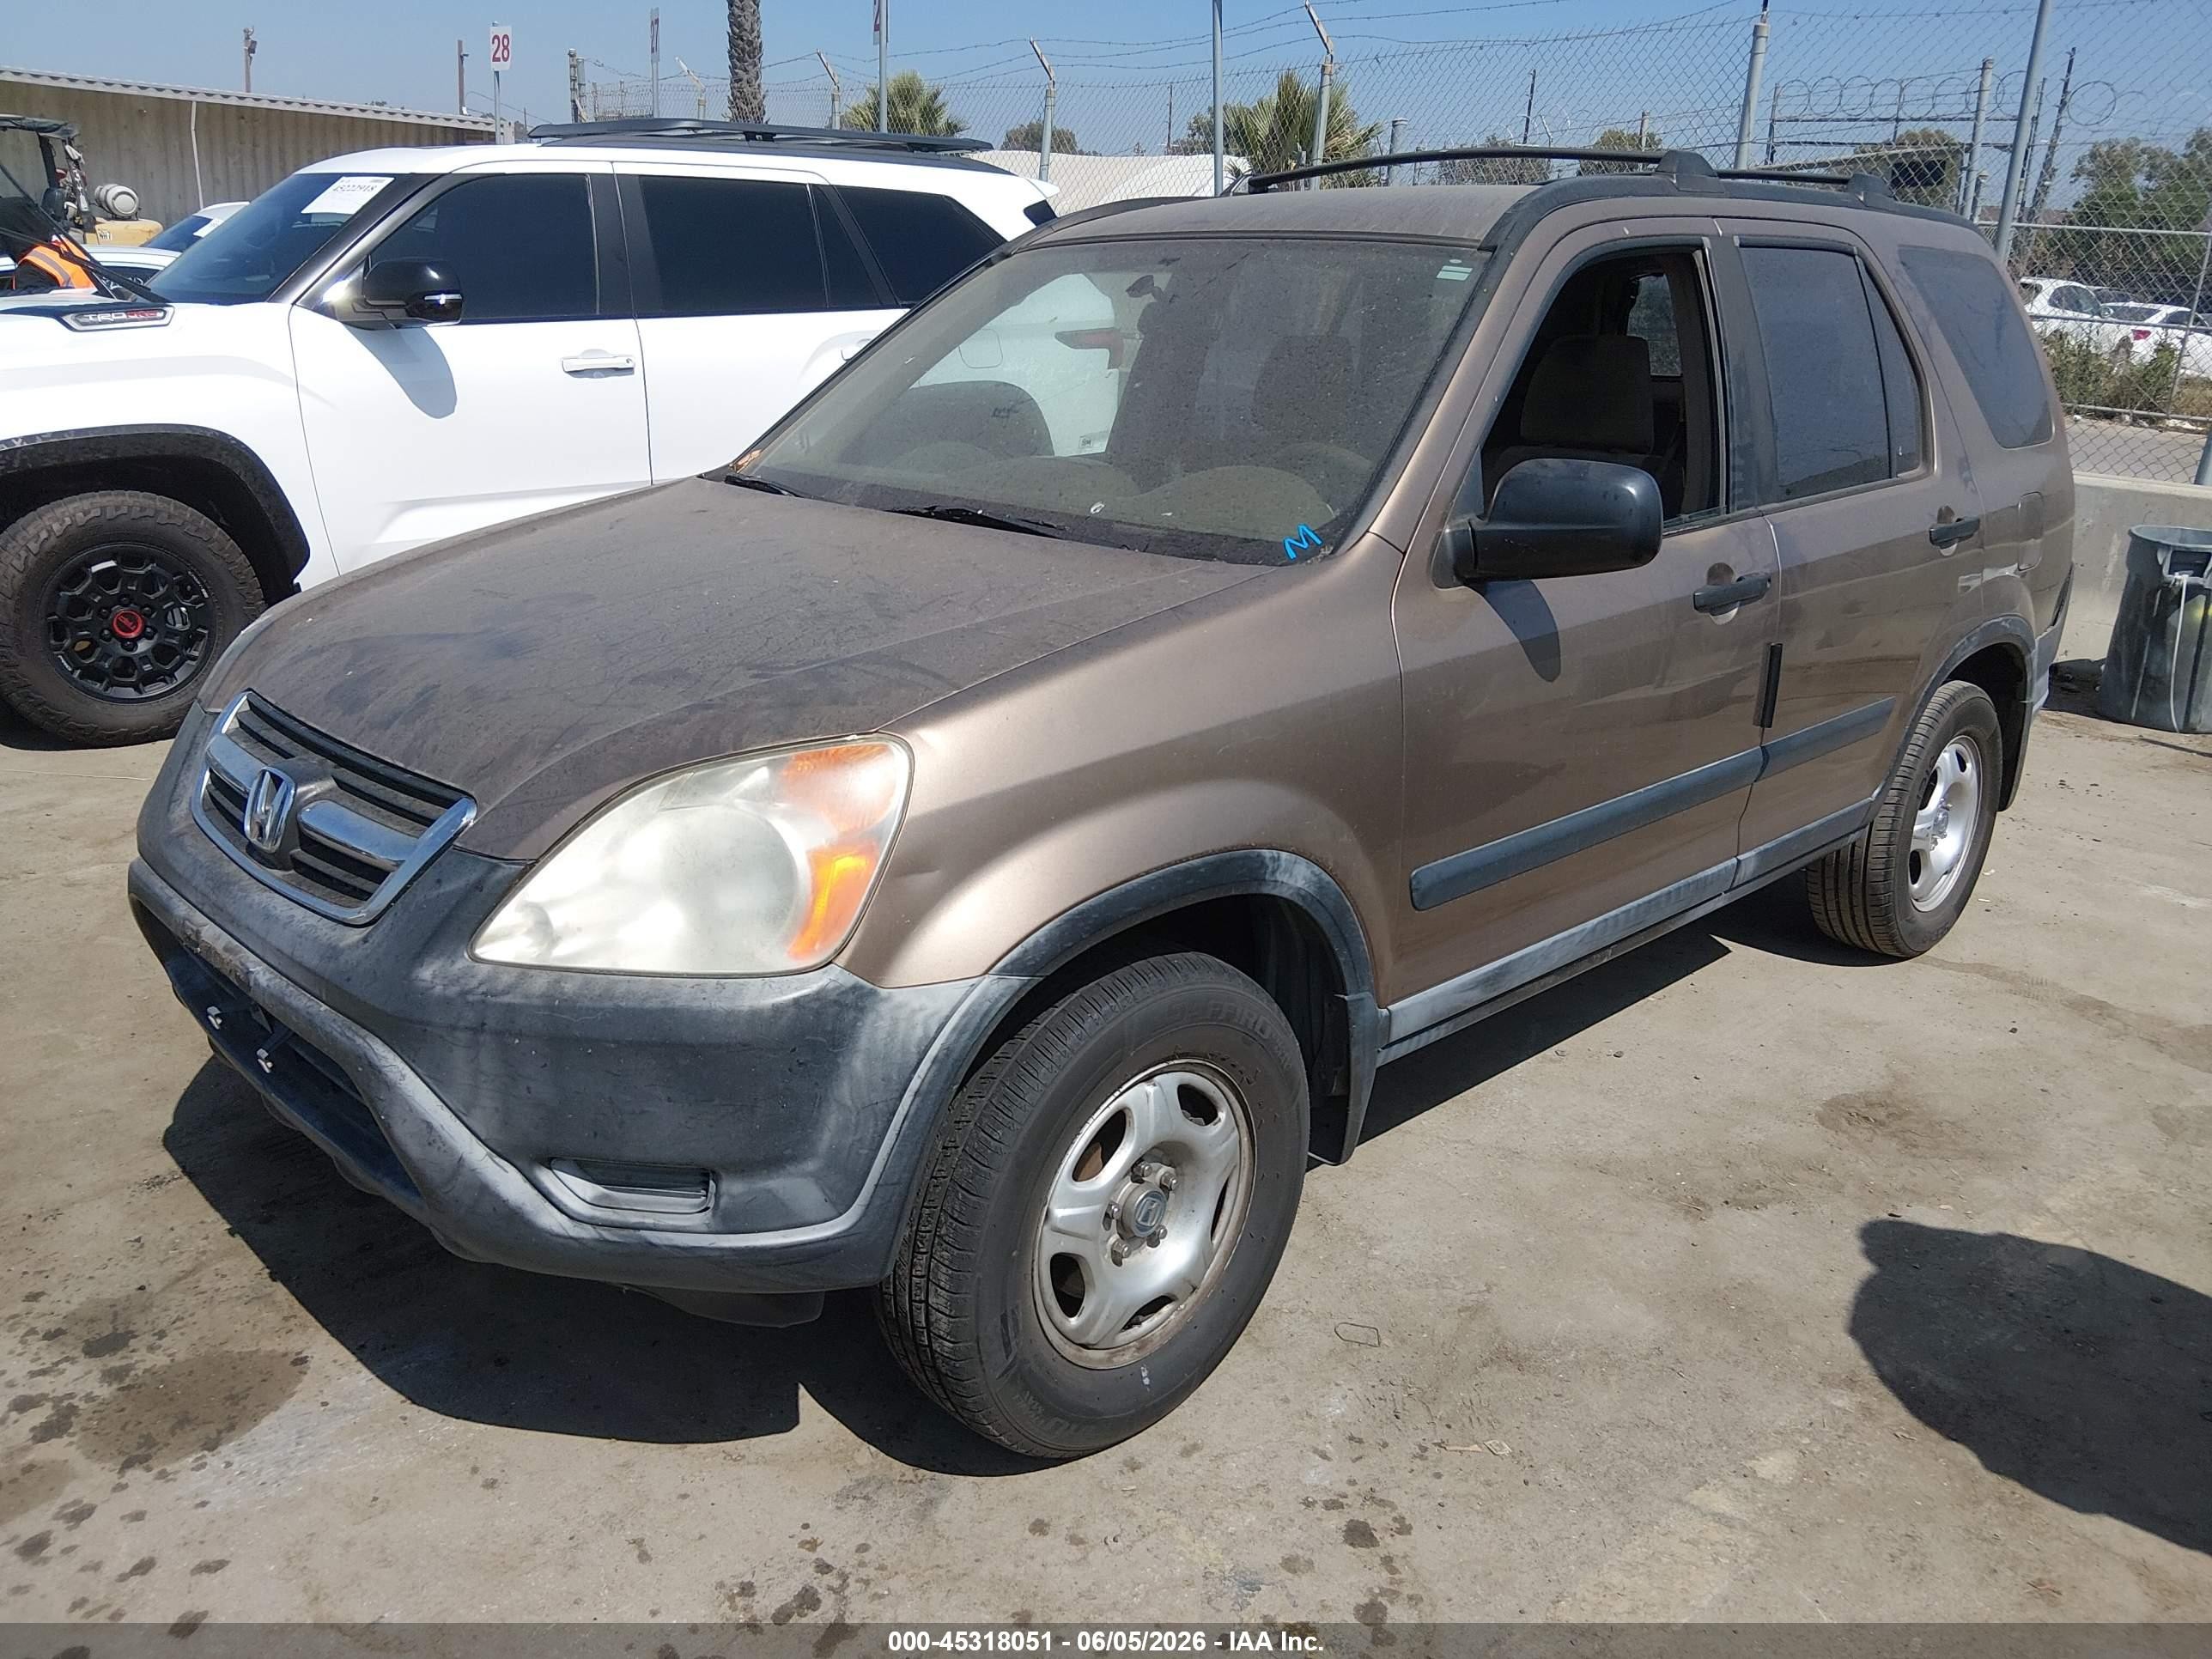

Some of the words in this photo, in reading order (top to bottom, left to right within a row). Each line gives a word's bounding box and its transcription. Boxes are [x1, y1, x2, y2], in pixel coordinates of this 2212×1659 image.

[492, 34, 510, 62] 28
[650, 18, 659, 53] 27
[1284, 524, 1322, 559] M
